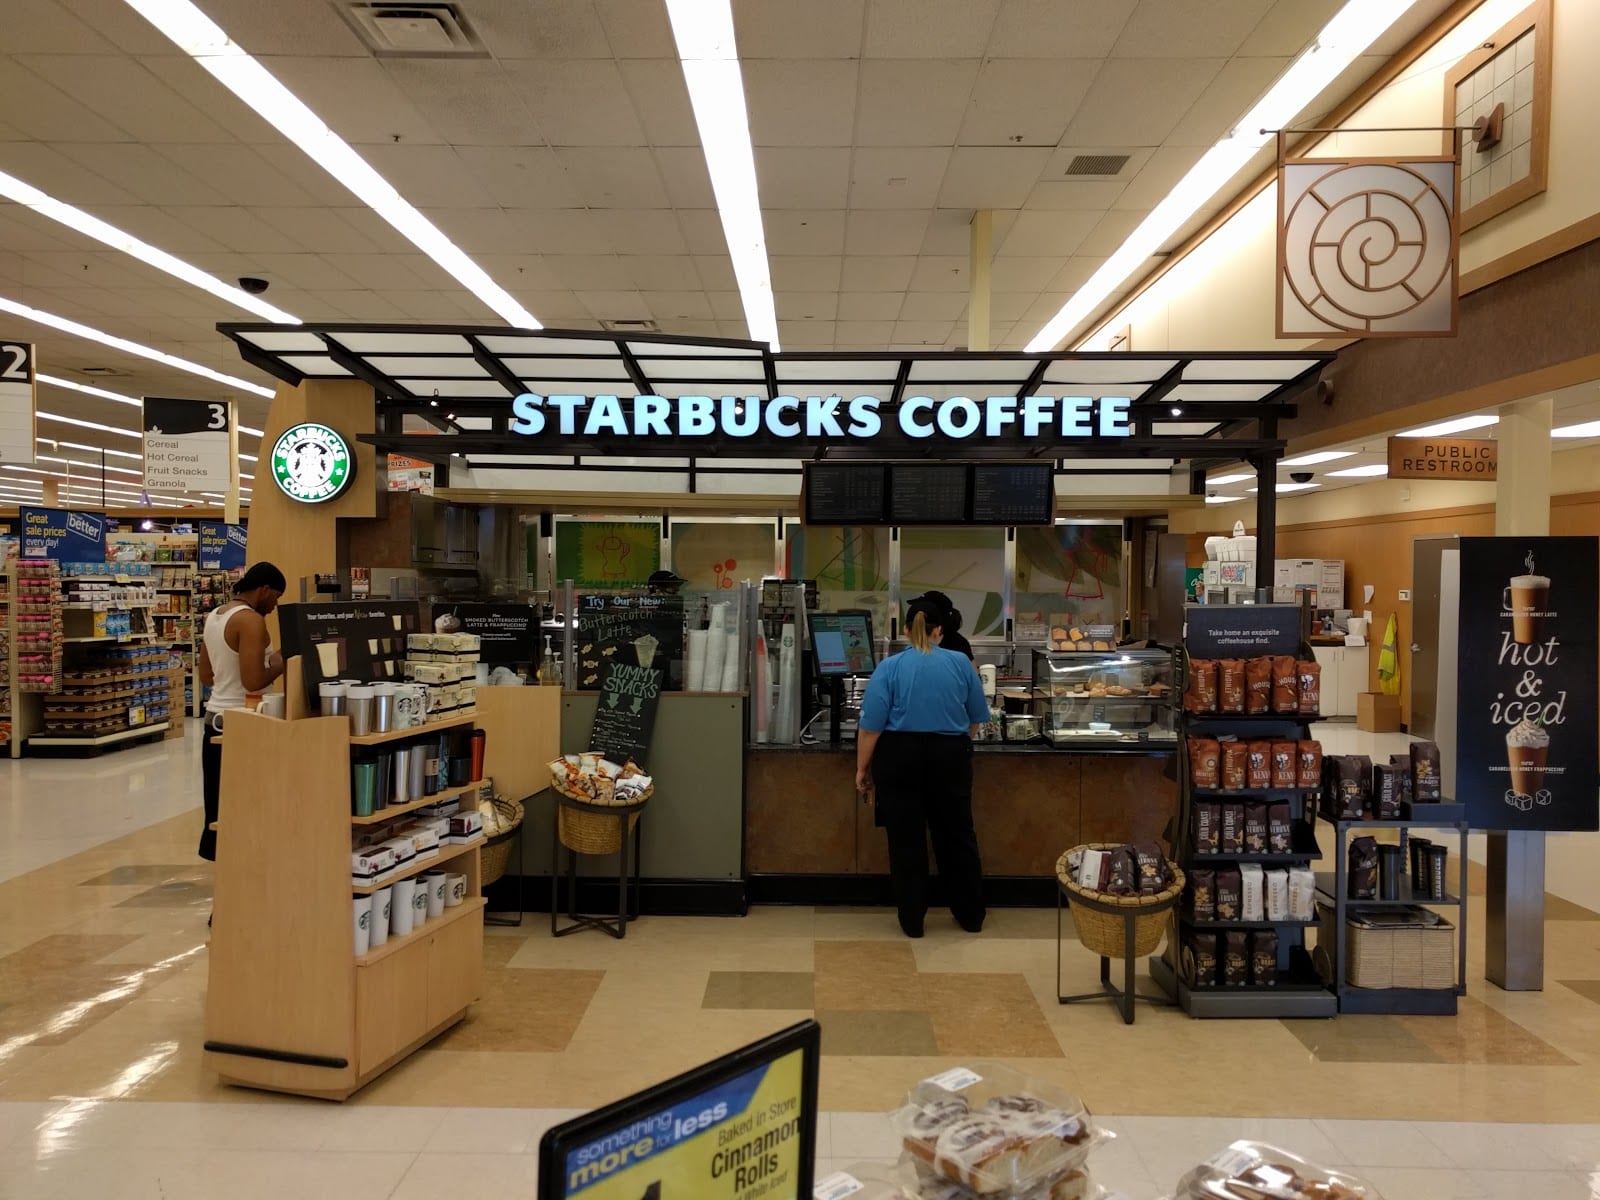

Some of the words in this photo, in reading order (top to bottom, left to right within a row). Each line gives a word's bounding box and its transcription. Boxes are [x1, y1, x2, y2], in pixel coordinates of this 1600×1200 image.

[1, 345, 28, 379] 2
[207, 403, 226, 429] 3
[511, 393, 882, 437] STARBUCKS
[899, 396, 1131, 438] COFFEE
[147, 440, 179, 448] Cereal
[276, 427, 346, 461] STARBUCKS
[1425, 445, 1490, 458] PUBLIC
[168, 453, 199, 462] Cereal
[147, 466, 169, 475] Fruit
[172, 466, 208, 476] Snacks
[147, 479, 186, 487] Granola
[283, 477, 336, 498] COFFEE
[25, 512, 49, 524] Great
[69, 513, 99, 537] better
[25, 525, 42, 535] sale
[43, 526, 67, 538] prices
[26, 538, 44, 547] every
[45, 538, 59, 548] day!
[585, 595, 605, 610] Try
[614, 596, 632, 606] Our
[579, 608, 654, 632] Butterscotch
[1251, 629, 1280, 637] exquisite
[1498, 632, 1560, 666] hot
[610, 662, 660, 684] YUMMY
[1515, 669, 1543, 697] &
[603, 677, 659, 699] SNACKS
[1490, 691, 1567, 725] iced
[718, 1113, 753, 1147] Baked
[755, 1111, 767, 1127] in
[768, 1096, 797, 1120] Store
[570, 1137, 654, 1188] more
[656, 1134, 673, 1149] for
[674, 1102, 728, 1140] less
[576, 1111, 672, 1164] something
[711, 1116, 801, 1178] Cinnamon
[735, 1153, 778, 1193] Rolls
